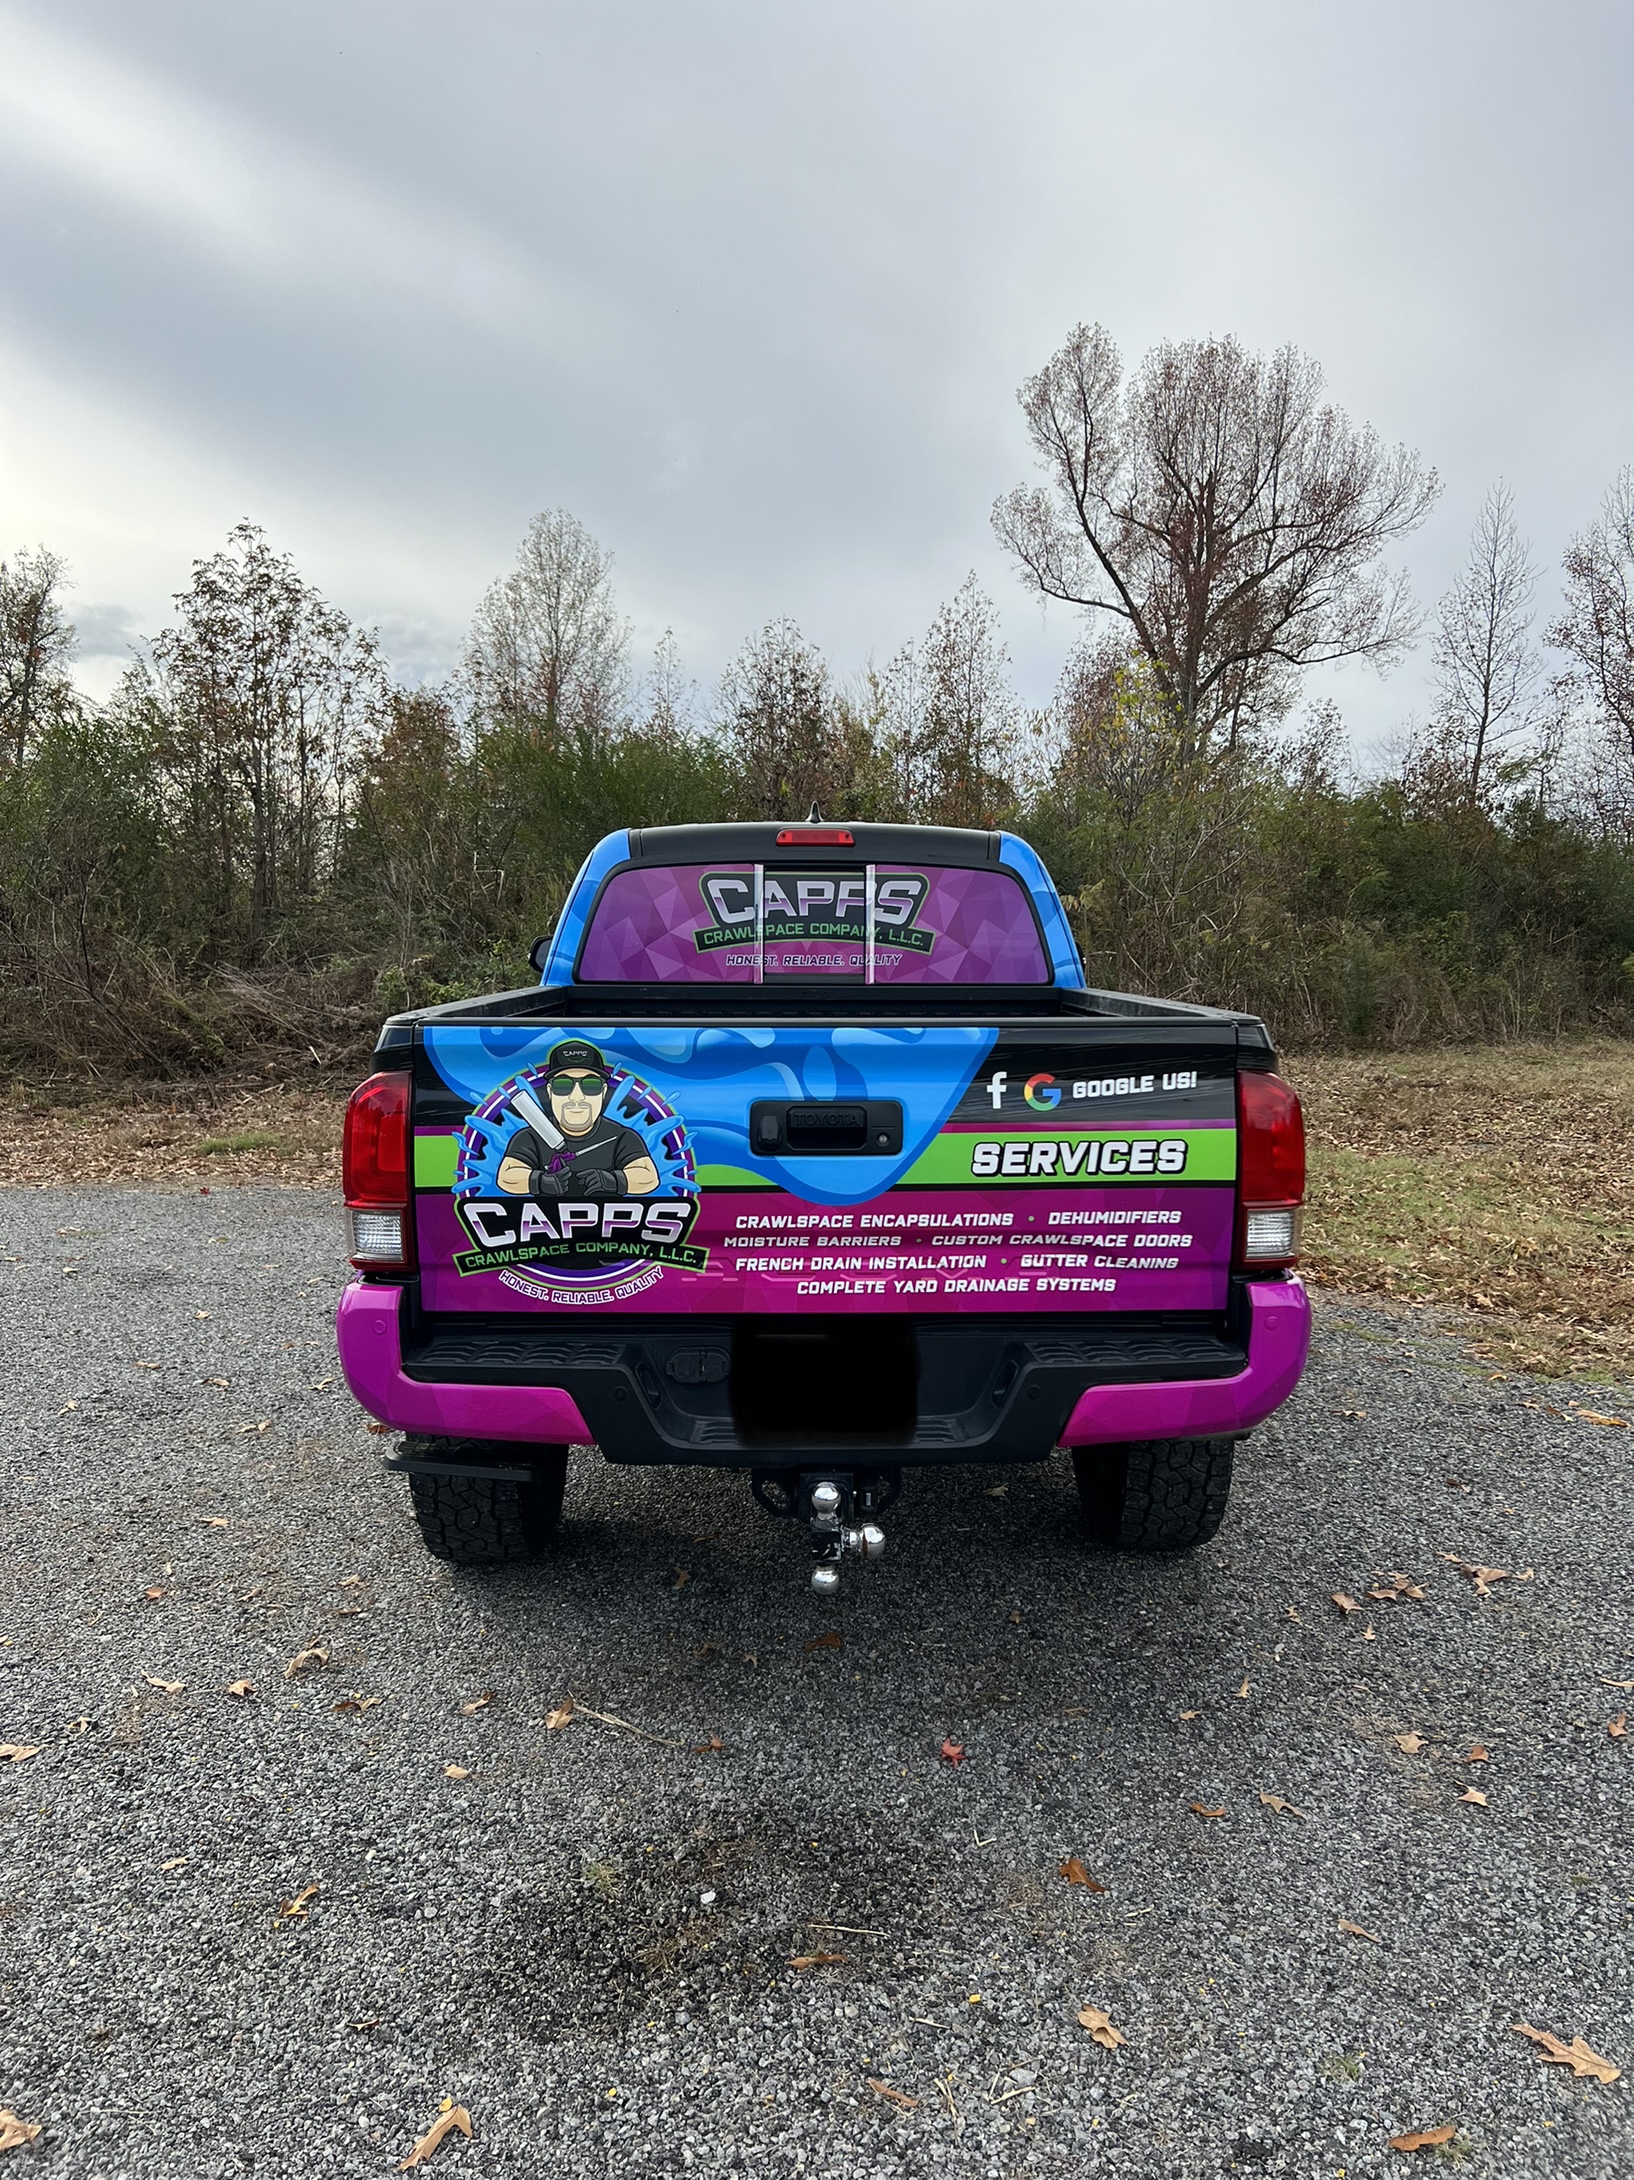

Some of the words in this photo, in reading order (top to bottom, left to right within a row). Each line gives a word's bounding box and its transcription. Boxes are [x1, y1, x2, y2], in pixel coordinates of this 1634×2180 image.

[707, 879, 922, 925] CAPPS
[704, 923, 804, 944] CRAWLSPACE
[889, 929, 923, 946] L.L.C.
[726, 954, 778, 967] HONEST.
[783, 954, 845, 967] RELIABLE.
[1072, 1075, 1155, 1099] GOOGLE
[1162, 1071, 1198, 1091] US!
[794, 1113, 861, 1126] TOYOTA
[972, 1139, 1188, 1177] SERVICES
[463, 1203, 691, 1248] CAPPS
[736, 1215, 854, 1229] CRAWLSPACE
[860, 1213, 1014, 1228] ENCAPSULATIONS
[1048, 1211, 1182, 1225] DEHUMIDIFIERS
[724, 1236, 810, 1247] MOISTURE
[817, 1236, 902, 1247] BARRIERS
[932, 1235, 1003, 1246] CUSTOM
[1009, 1234, 1128, 1247] CRAWLSPACE
[1134, 1235, 1193, 1247] DOORS
[465, 1244, 570, 1268] CRAWLSPACE
[576, 1242, 654, 1257] COMPANY,
[659, 1247, 697, 1263] L.L.C.
[736, 1257, 804, 1271] FRENCH
[811, 1257, 862, 1271] DRAIN
[869, 1255, 987, 1270] INSTALLATION
[1021, 1254, 1088, 1268] GUTTER
[1094, 1255, 1179, 1269] CLEANING
[499, 1269, 549, 1301] HONEST.
[552, 1290, 614, 1305] RELIABLE.
[616, 1266, 664, 1299] QUALITY
[797, 1281, 886, 1295] COMPLETE
[893, 1279, 938, 1293] YARD
[944, 1279, 1030, 1293] DRAINAGE
[1036, 1278, 1117, 1292] SYSTEMS
